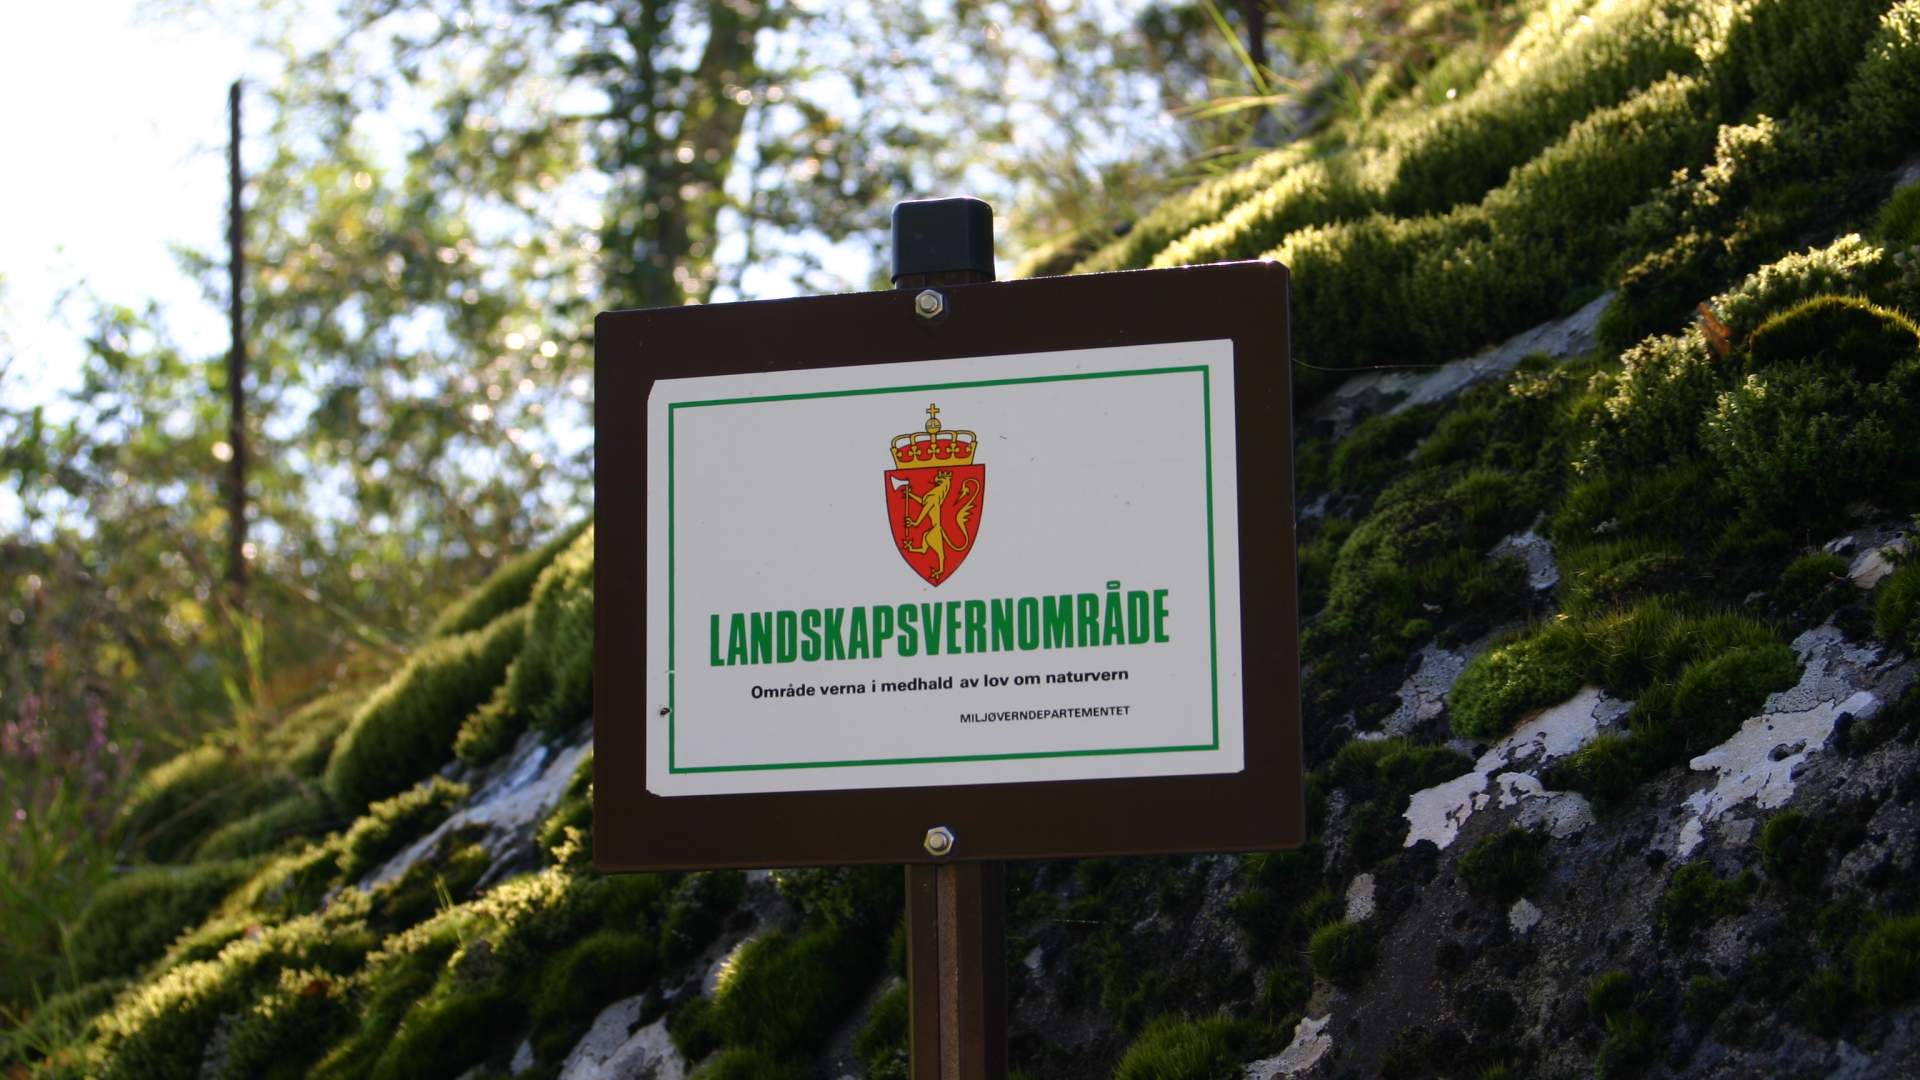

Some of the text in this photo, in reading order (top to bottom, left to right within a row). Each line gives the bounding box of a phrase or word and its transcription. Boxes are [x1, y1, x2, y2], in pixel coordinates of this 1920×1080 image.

[710, 580, 1170, 668] LANDSKAPSVERNOMRÅDE
[751, 670, 1129, 699] Område verna i medhald av lov om naturvern
[960, 705, 1130, 724] MILJØVERNDEPARTEMENTET
